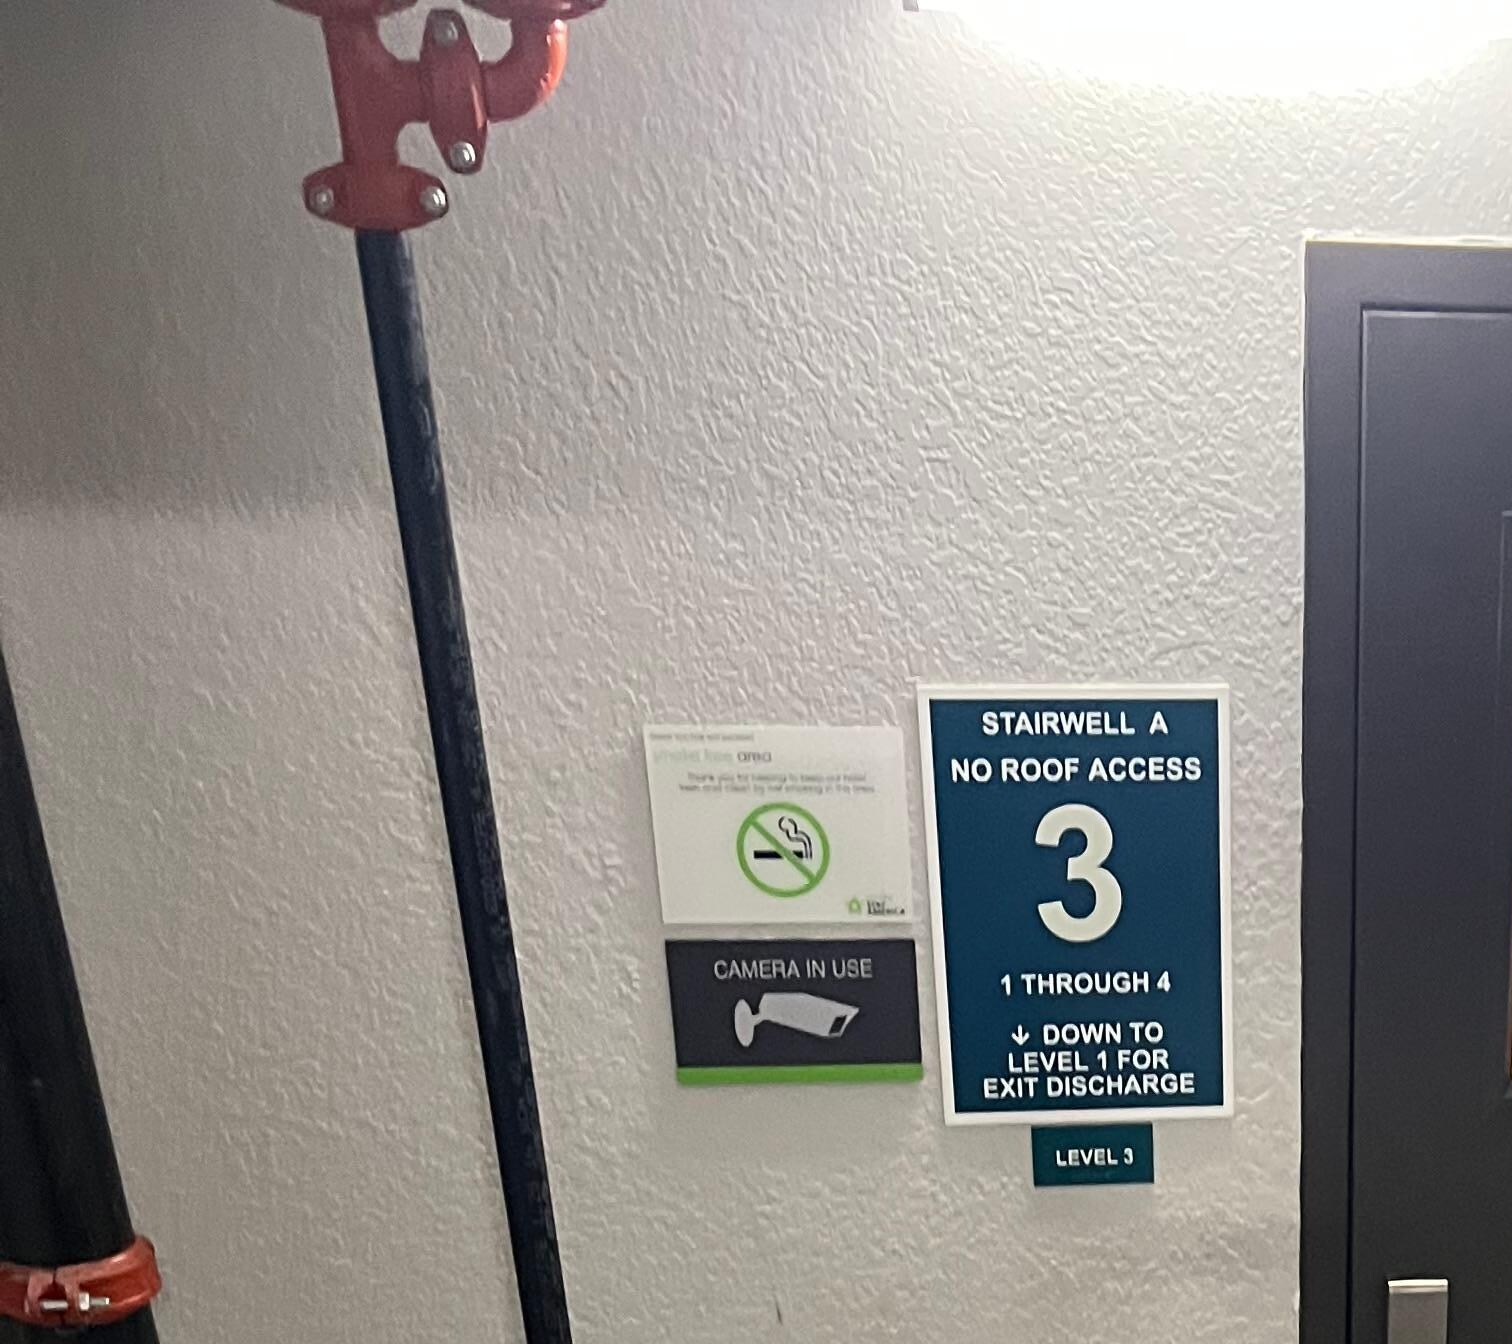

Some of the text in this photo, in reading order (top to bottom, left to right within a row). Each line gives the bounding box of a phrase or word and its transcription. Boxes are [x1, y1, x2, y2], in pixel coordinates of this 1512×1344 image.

[982, 711, 1169, 736] STAIRWELL A
[951, 756, 1202, 783] NO ROOF ACCESS
[1034, 802, 1123, 943] 3
[713, 958, 873, 980] CAMERA IN USE
[1000, 970, 1171, 996] 1 THROUGH 4
[1043, 1021, 1164, 1046] DOWN TO
[1008, 1048, 1169, 1074] LEVEL 1 FOR
[983, 1072, 1195, 1099] EXIT DISCHARGE
[1055, 1147, 1134, 1167] LEVEL 3
